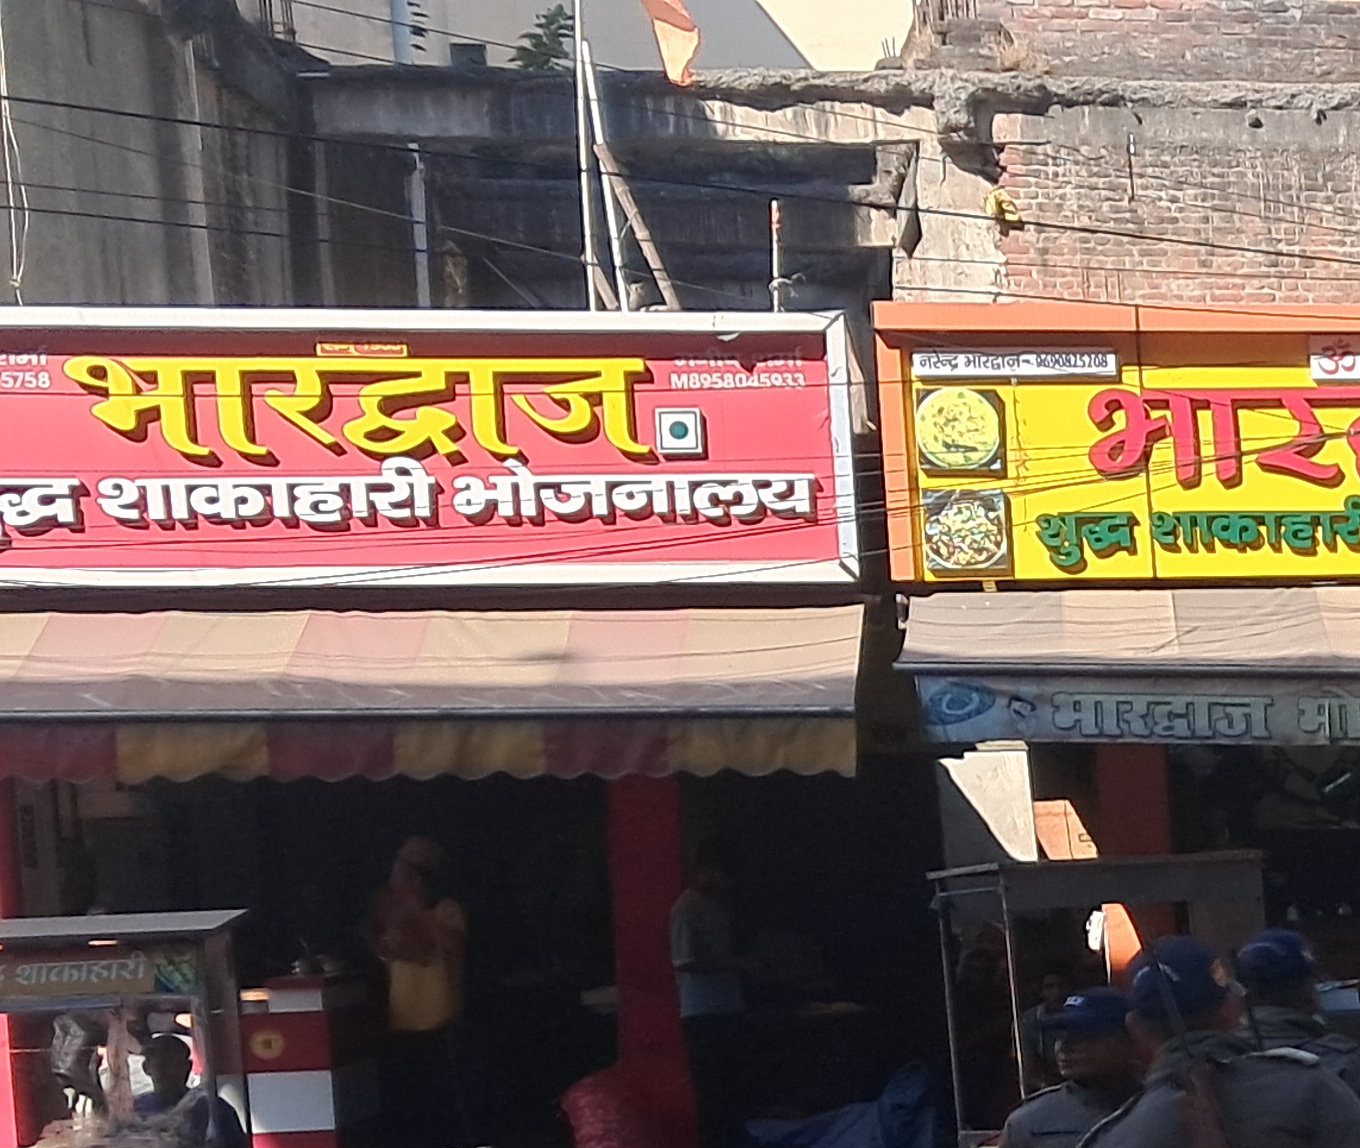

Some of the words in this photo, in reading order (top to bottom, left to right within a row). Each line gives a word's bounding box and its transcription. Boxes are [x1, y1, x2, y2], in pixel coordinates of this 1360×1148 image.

[63, 355, 651, 460] भारद्वाज
[98, 455, 437, 524] शाकाहारी
[453, 458, 817, 519] भोजनालय
[1036, 511, 1139, 573] शुद्ध
[1051, 692, 1274, 739] भारद्वाज
